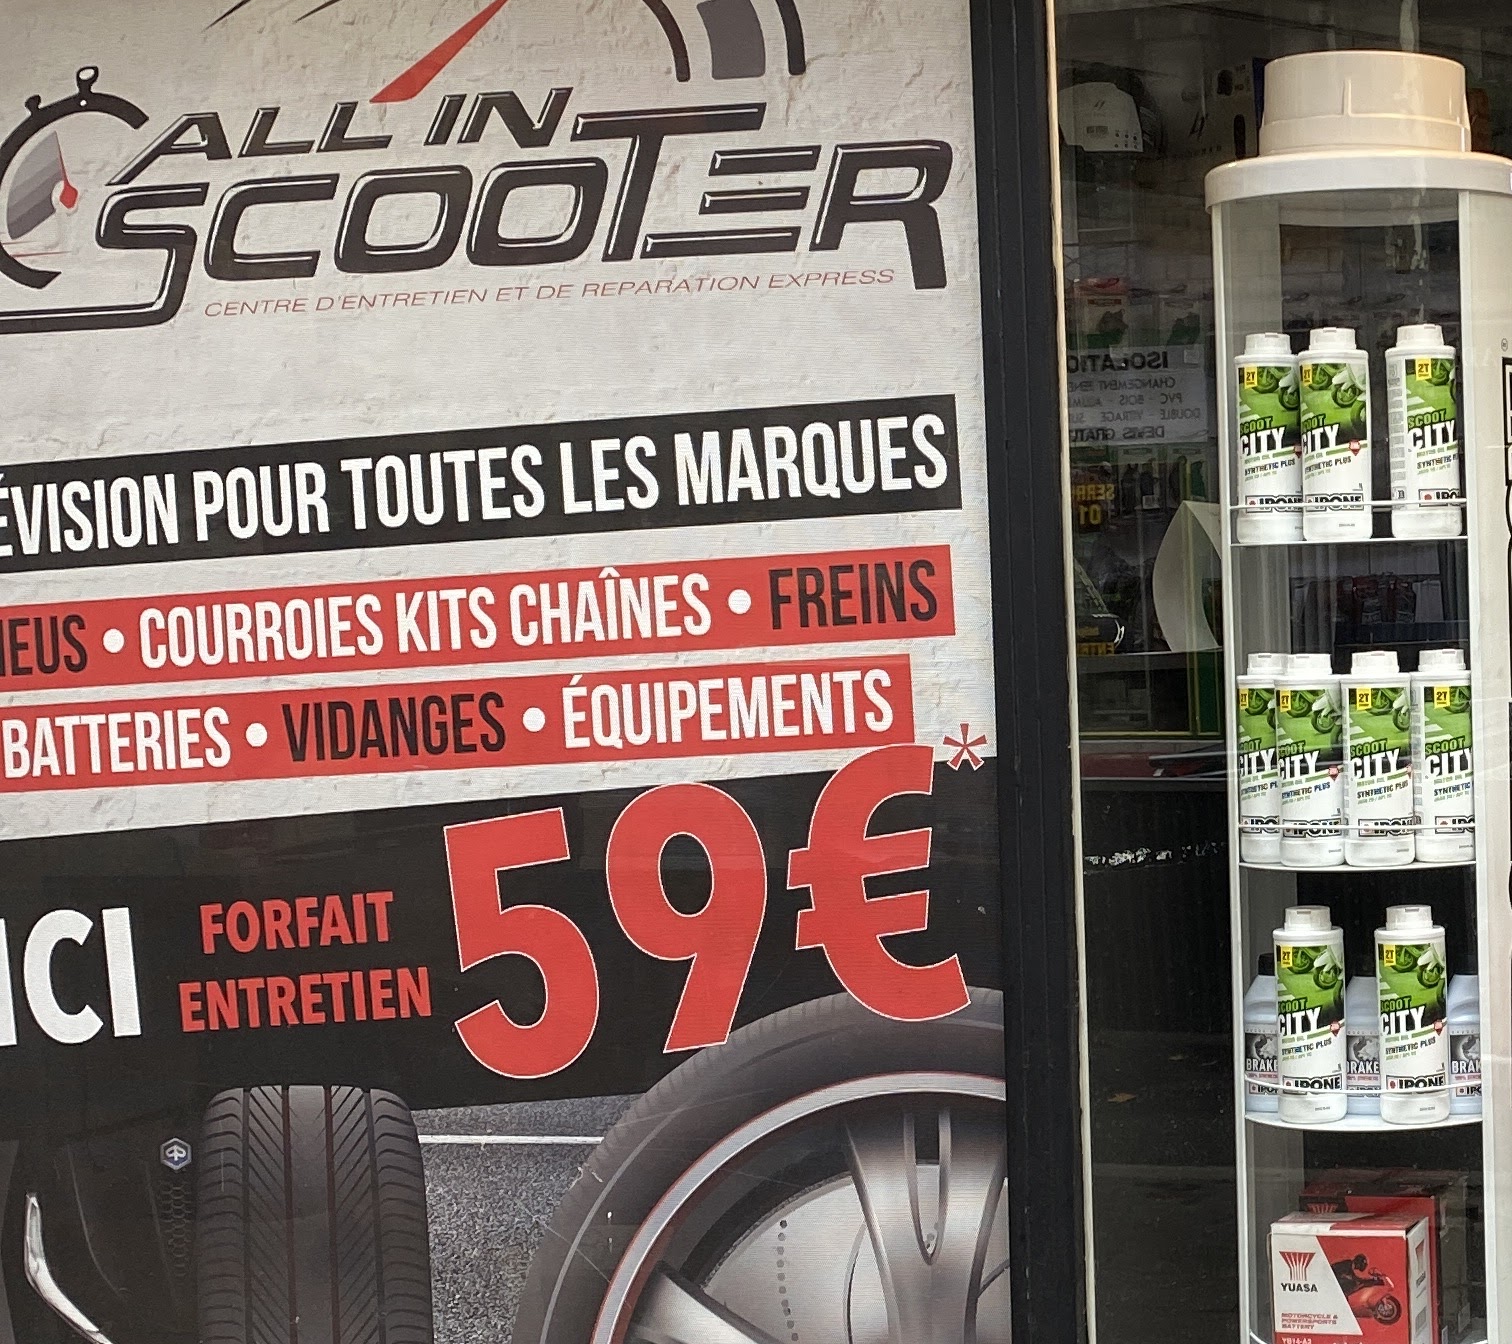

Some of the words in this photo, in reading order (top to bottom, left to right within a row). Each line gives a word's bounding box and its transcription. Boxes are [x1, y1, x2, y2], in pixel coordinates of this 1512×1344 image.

[106, 103, 392, 185] ALL
[425, 88, 572, 147] IN
[0, 103, 952, 334] SCOOTER
[204, 296, 308, 318] CENTRE
[316, 288, 489, 312] D'ENTRETIEN
[495, 285, 528, 304] ET
[536, 283, 574, 302] DE
[582, 274, 760, 299] REPARATION
[768, 267, 896, 291] EXPRESS
[1418, 363, 1429, 374] 2T
[1408, 410, 1446, 429] SCOOT
[1241, 426, 1285, 456] CITY
[1408, 420, 1456, 452] CITY
[193, 460, 331, 542] POUR
[341, 444, 544, 528] TOUTES
[561, 434, 659, 514] LES
[675, 413, 948, 506] MARQUES
[0, 614, 88, 677] EUS
[139, 593, 381, 669] COURROIES
[397, 584, 498, 652] KITS
[509, 565, 712, 644] CHAÎNES
[768, 559, 938, 629] FREINS
[1359, 693, 1369, 703] 2T
[1436, 692, 1447, 701] 2T
[2, 706, 231, 780] BATTERIES
[281, 690, 507, 763] VIDANGES
[561, 667, 894, 749] ÉQUIPEMENTS
[1350, 740, 1387, 757] SCOOT
[1425, 738, 1464, 755] SCOOT
[1279, 751, 1319, 780] CITY
[1350, 749, 1400, 780] CITY
[1425, 748, 1473, 777] CITY
[200, 890, 393, 955] FORFAIT
[1385, 950, 1394, 960] 2T
[178, 966, 432, 1034] ENTRETIEN
[1279, 1007, 1321, 1037] CITY
[1381, 1006, 1425, 1036] CITY
[1281, 1282, 1318, 1293] YUASA
